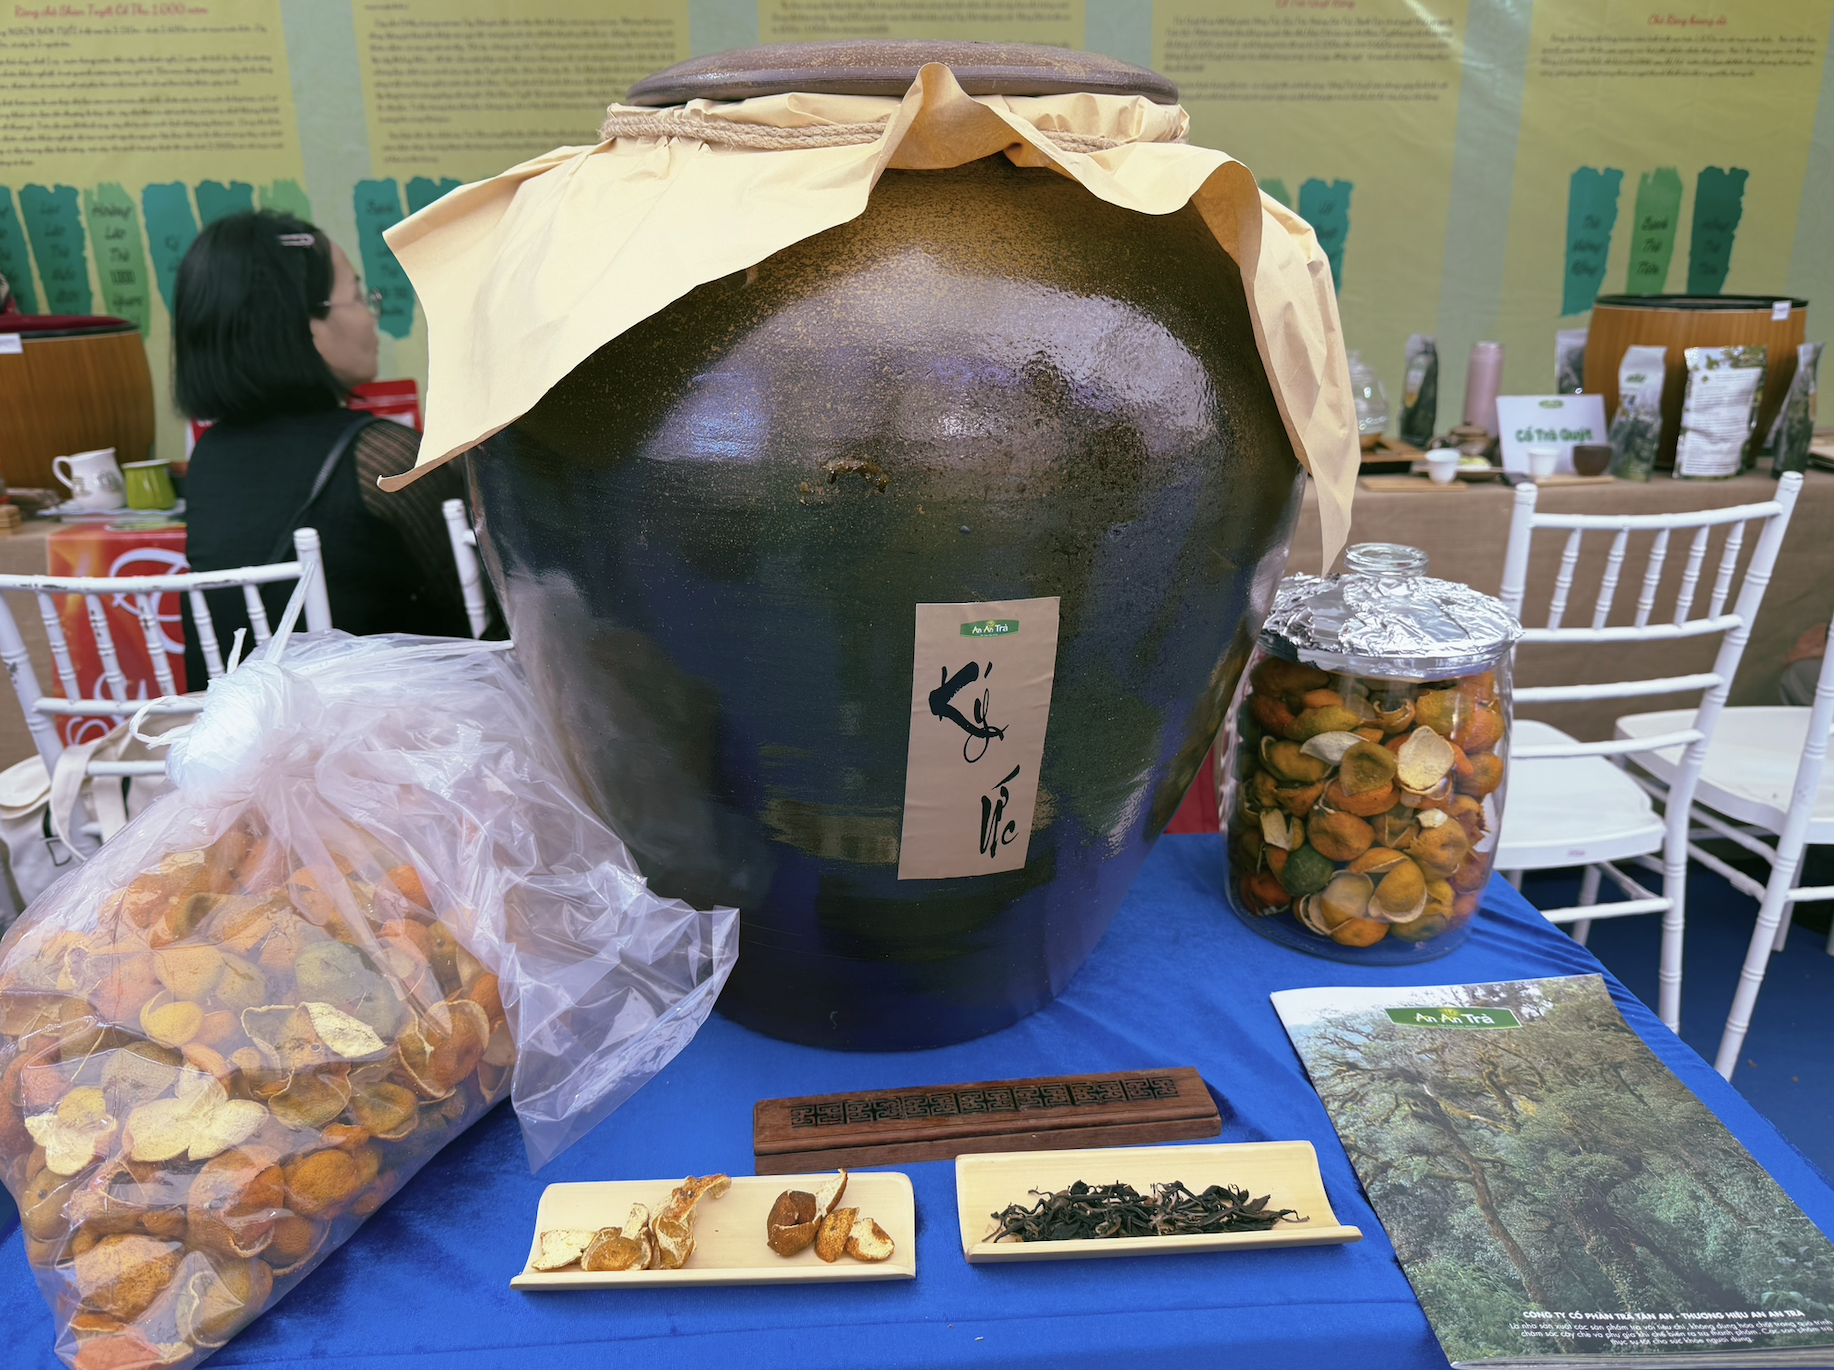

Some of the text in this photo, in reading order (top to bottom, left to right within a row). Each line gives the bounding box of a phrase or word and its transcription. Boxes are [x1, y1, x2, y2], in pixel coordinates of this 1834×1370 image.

[1535, 427, 1558, 442] Trà
[972, 624, 1009, 634] An An Trà
[1414, 1012, 1495, 1025] An An Trà
[1523, 1311, 1553, 1319] CÔNG
[1614, 1311, 1634, 1320] TRÀ
[1659, 1312, 1674, 1320] AN
[1751, 1311, 1767, 1319] AN
[1769, 1310, 1784, 1318] AN
[1784, 1308, 1805, 1318] TRÀ
